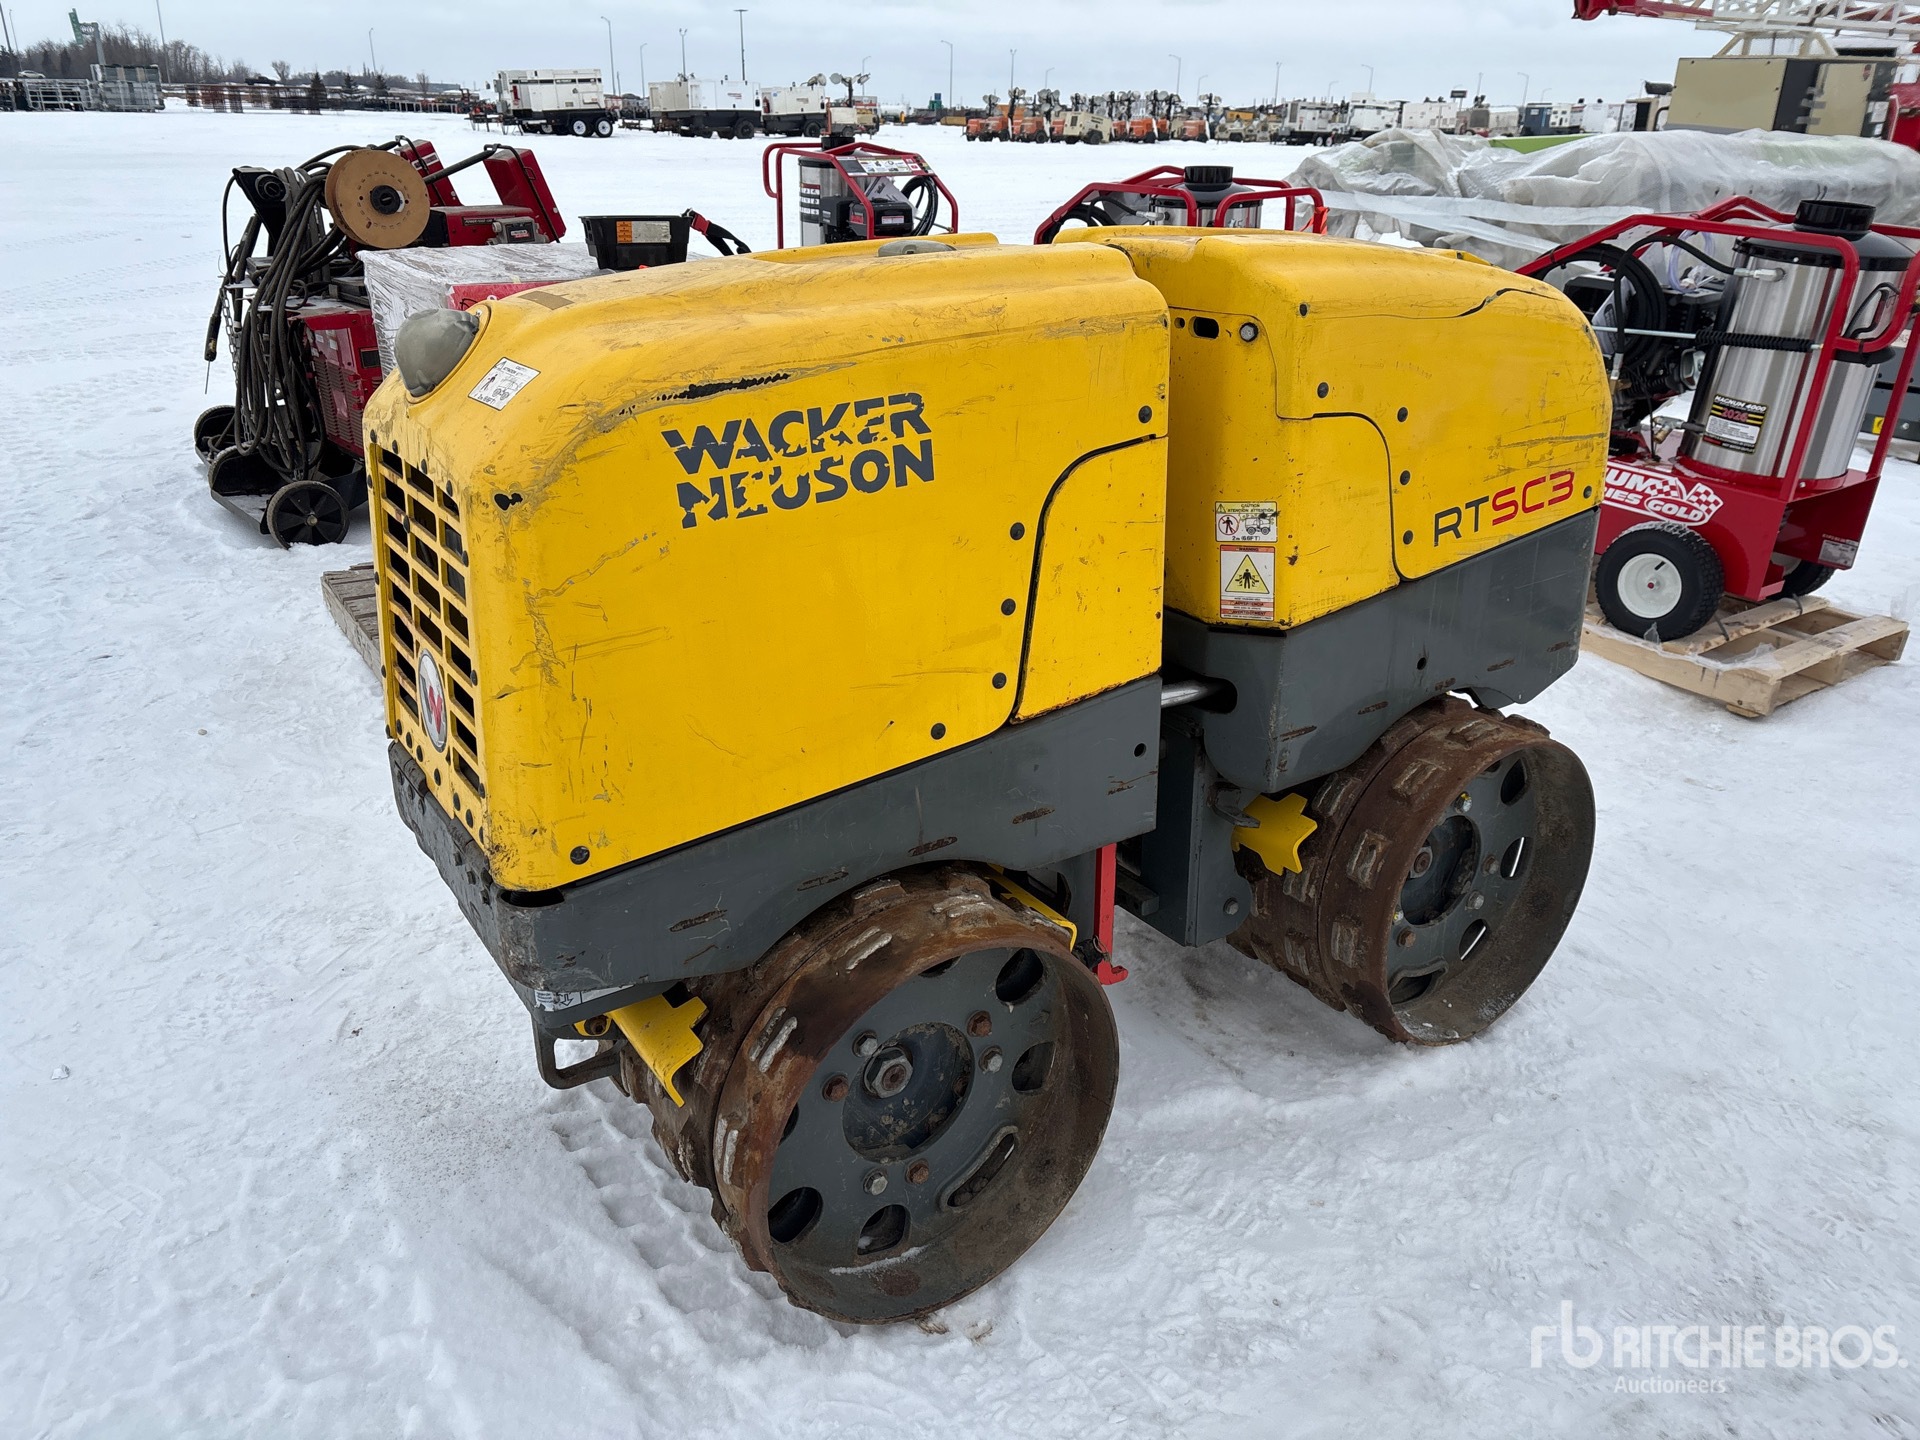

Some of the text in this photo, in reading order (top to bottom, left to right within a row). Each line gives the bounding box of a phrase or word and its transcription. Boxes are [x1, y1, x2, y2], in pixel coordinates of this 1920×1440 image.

[1714, 395, 1746, 408] MAGNUM
[1745, 403, 1767, 412] 4000
[662, 392, 931, 475] WACKER
[676, 438, 936, 530] NEUSON
[1647, 499, 1704, 522] GOLD
